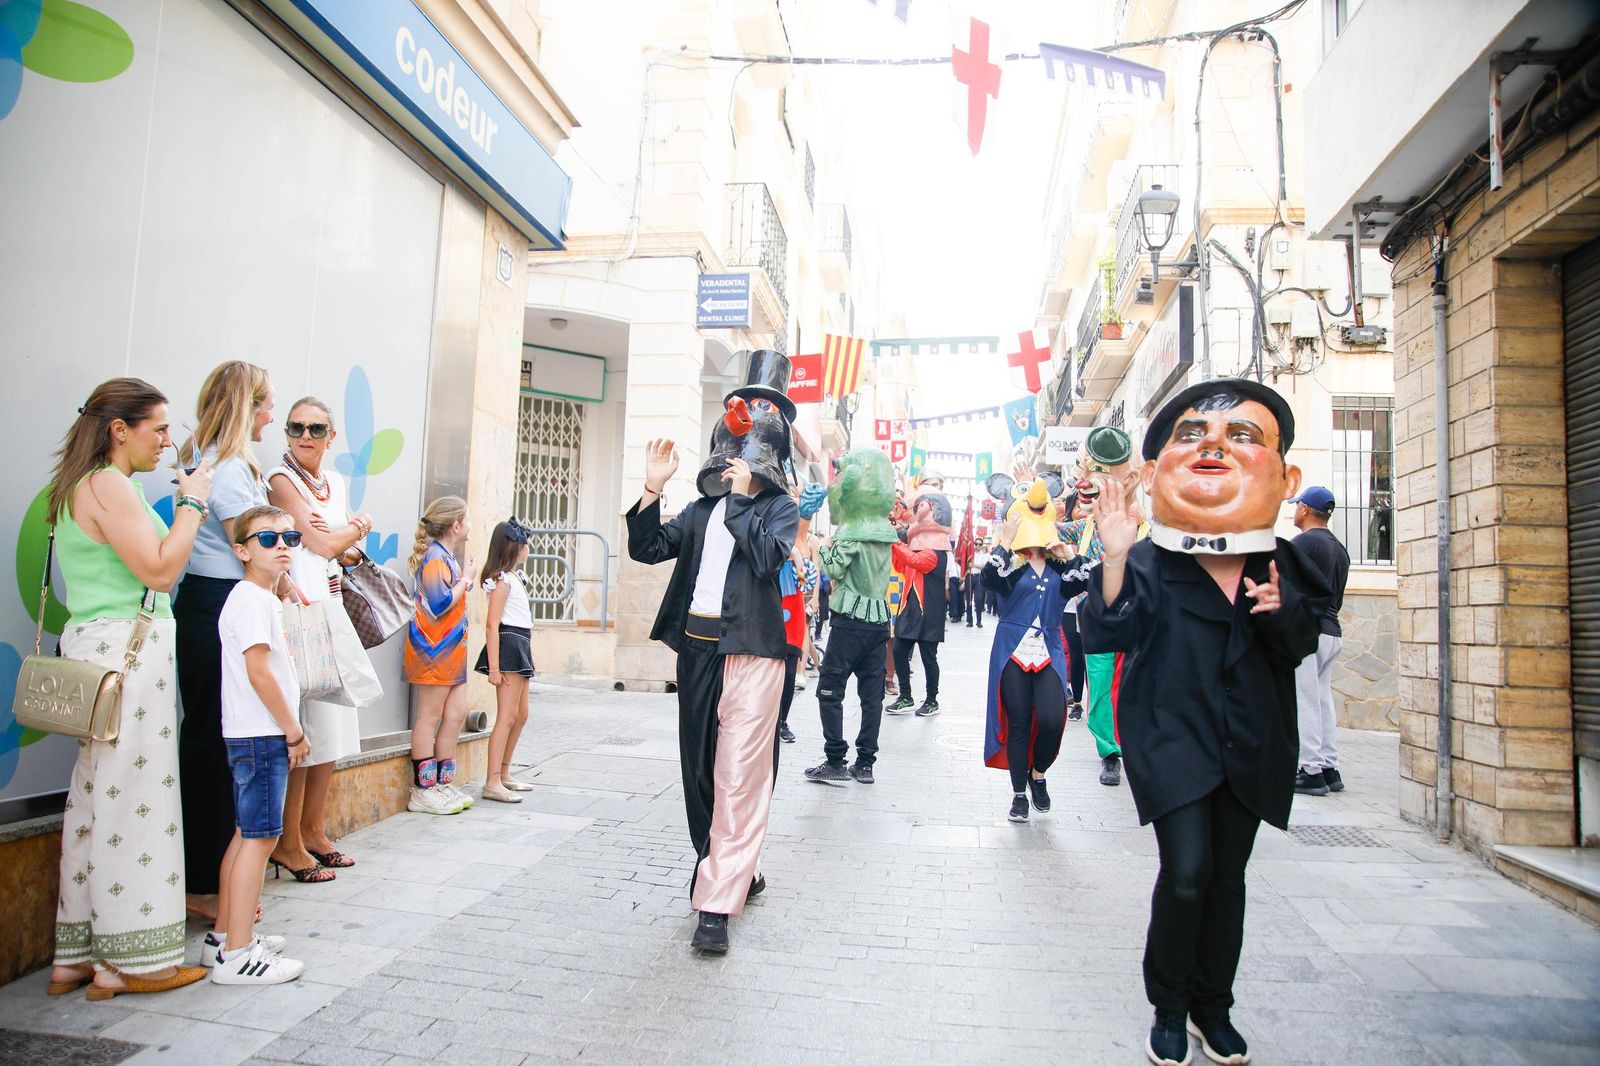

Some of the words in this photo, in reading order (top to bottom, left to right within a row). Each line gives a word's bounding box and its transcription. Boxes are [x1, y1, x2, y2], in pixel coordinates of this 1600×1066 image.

[395, 26, 498, 156] codeur
[701, 279, 747, 287] VERADENTAL
[789, 379, 818, 389] APFRE
[28, 672, 84, 703] LOLA
